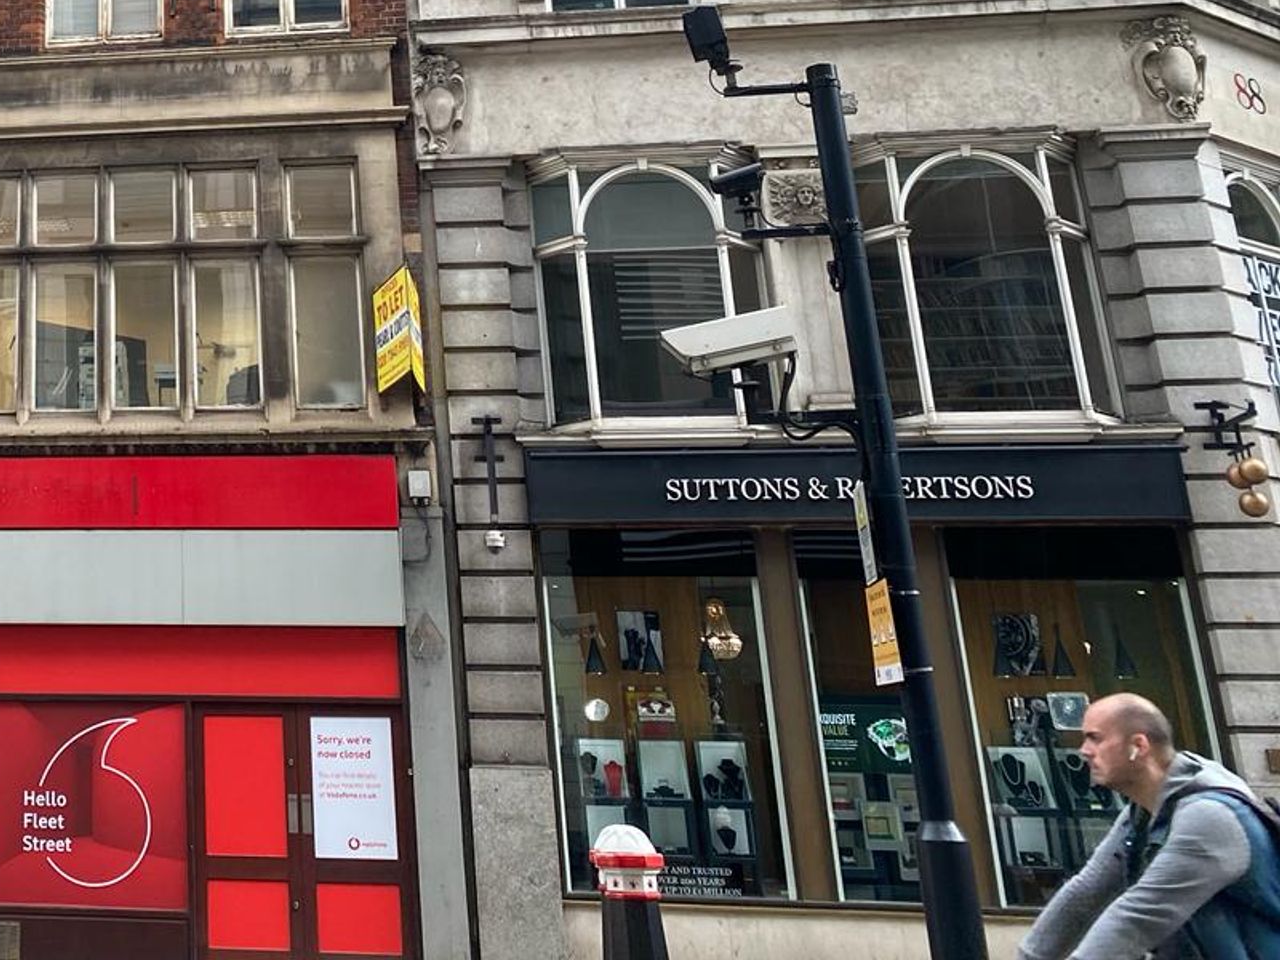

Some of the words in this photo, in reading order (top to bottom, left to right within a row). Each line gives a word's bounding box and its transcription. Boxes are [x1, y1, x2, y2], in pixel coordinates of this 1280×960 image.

[376, 301, 388, 324] TO
[389, 286, 404, 314] LET
[665, 477, 800, 501] SUTTONS
[807, 477, 830, 501] &
[834, 475, 1034, 500] RERTSONS
[317, 734, 345, 746] Sorry,
[346, 735, 372, 745] we're
[317, 750, 338, 760] now
[339, 750, 371, 760] closed
[23, 790, 67, 807] Hello
[23, 812, 65, 829] Fleet
[22, 834, 72, 852] Street
[671, 866, 690, 875] AND
[692, 867, 733, 877] TRUSTED
[697, 876, 726, 886] YEARS
[677, 887, 691, 895] TO
[703, 888, 742, 897] MILLION
